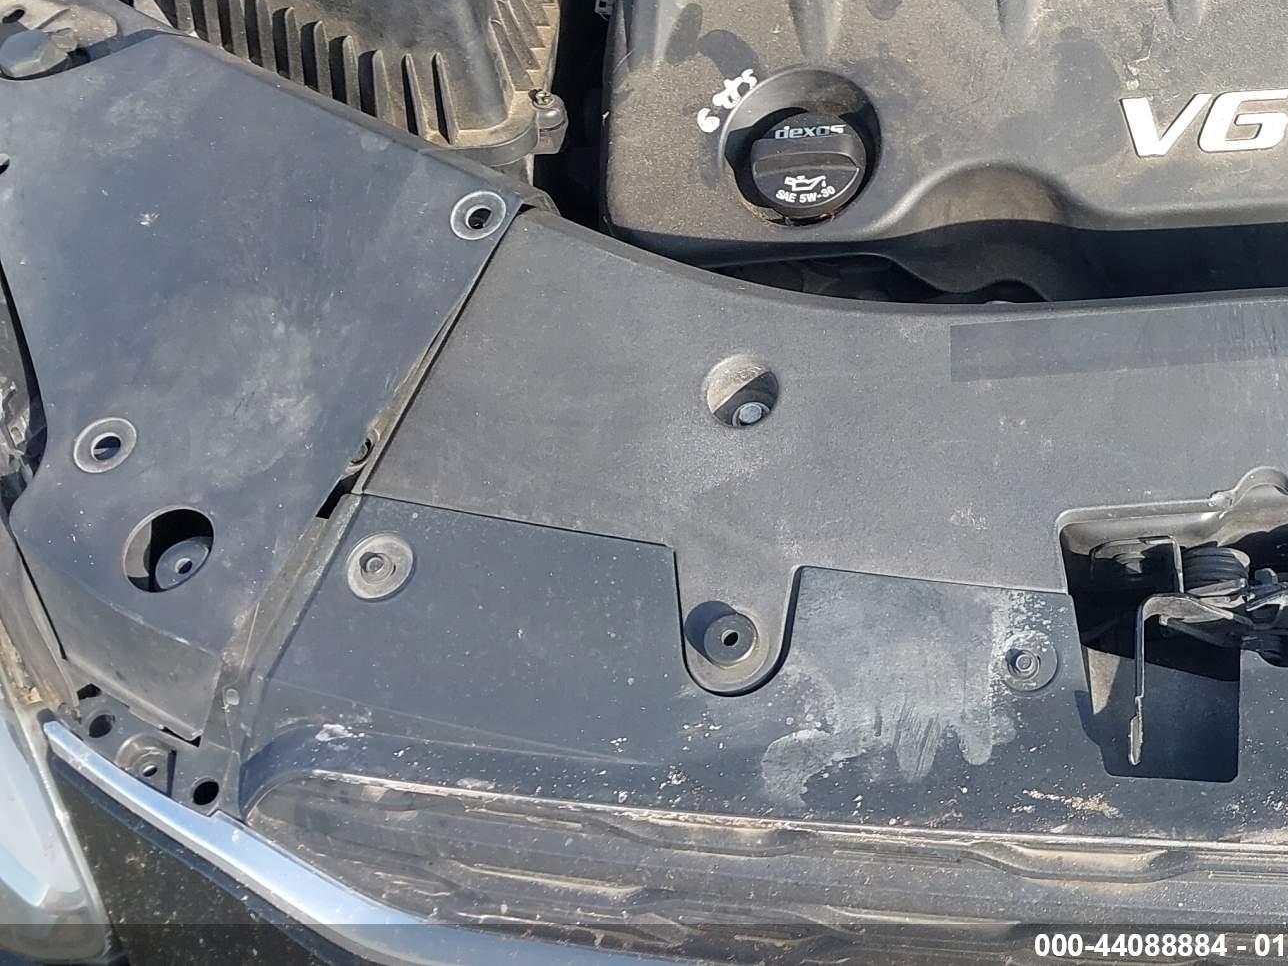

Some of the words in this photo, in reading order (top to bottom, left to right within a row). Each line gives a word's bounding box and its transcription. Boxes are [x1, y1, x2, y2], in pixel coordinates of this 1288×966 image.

[697, 107, 720, 133] 6
[775, 124, 847, 140] dexos
[775, 189, 796, 203] SAE
[799, 185, 836, 203] 5W-30
